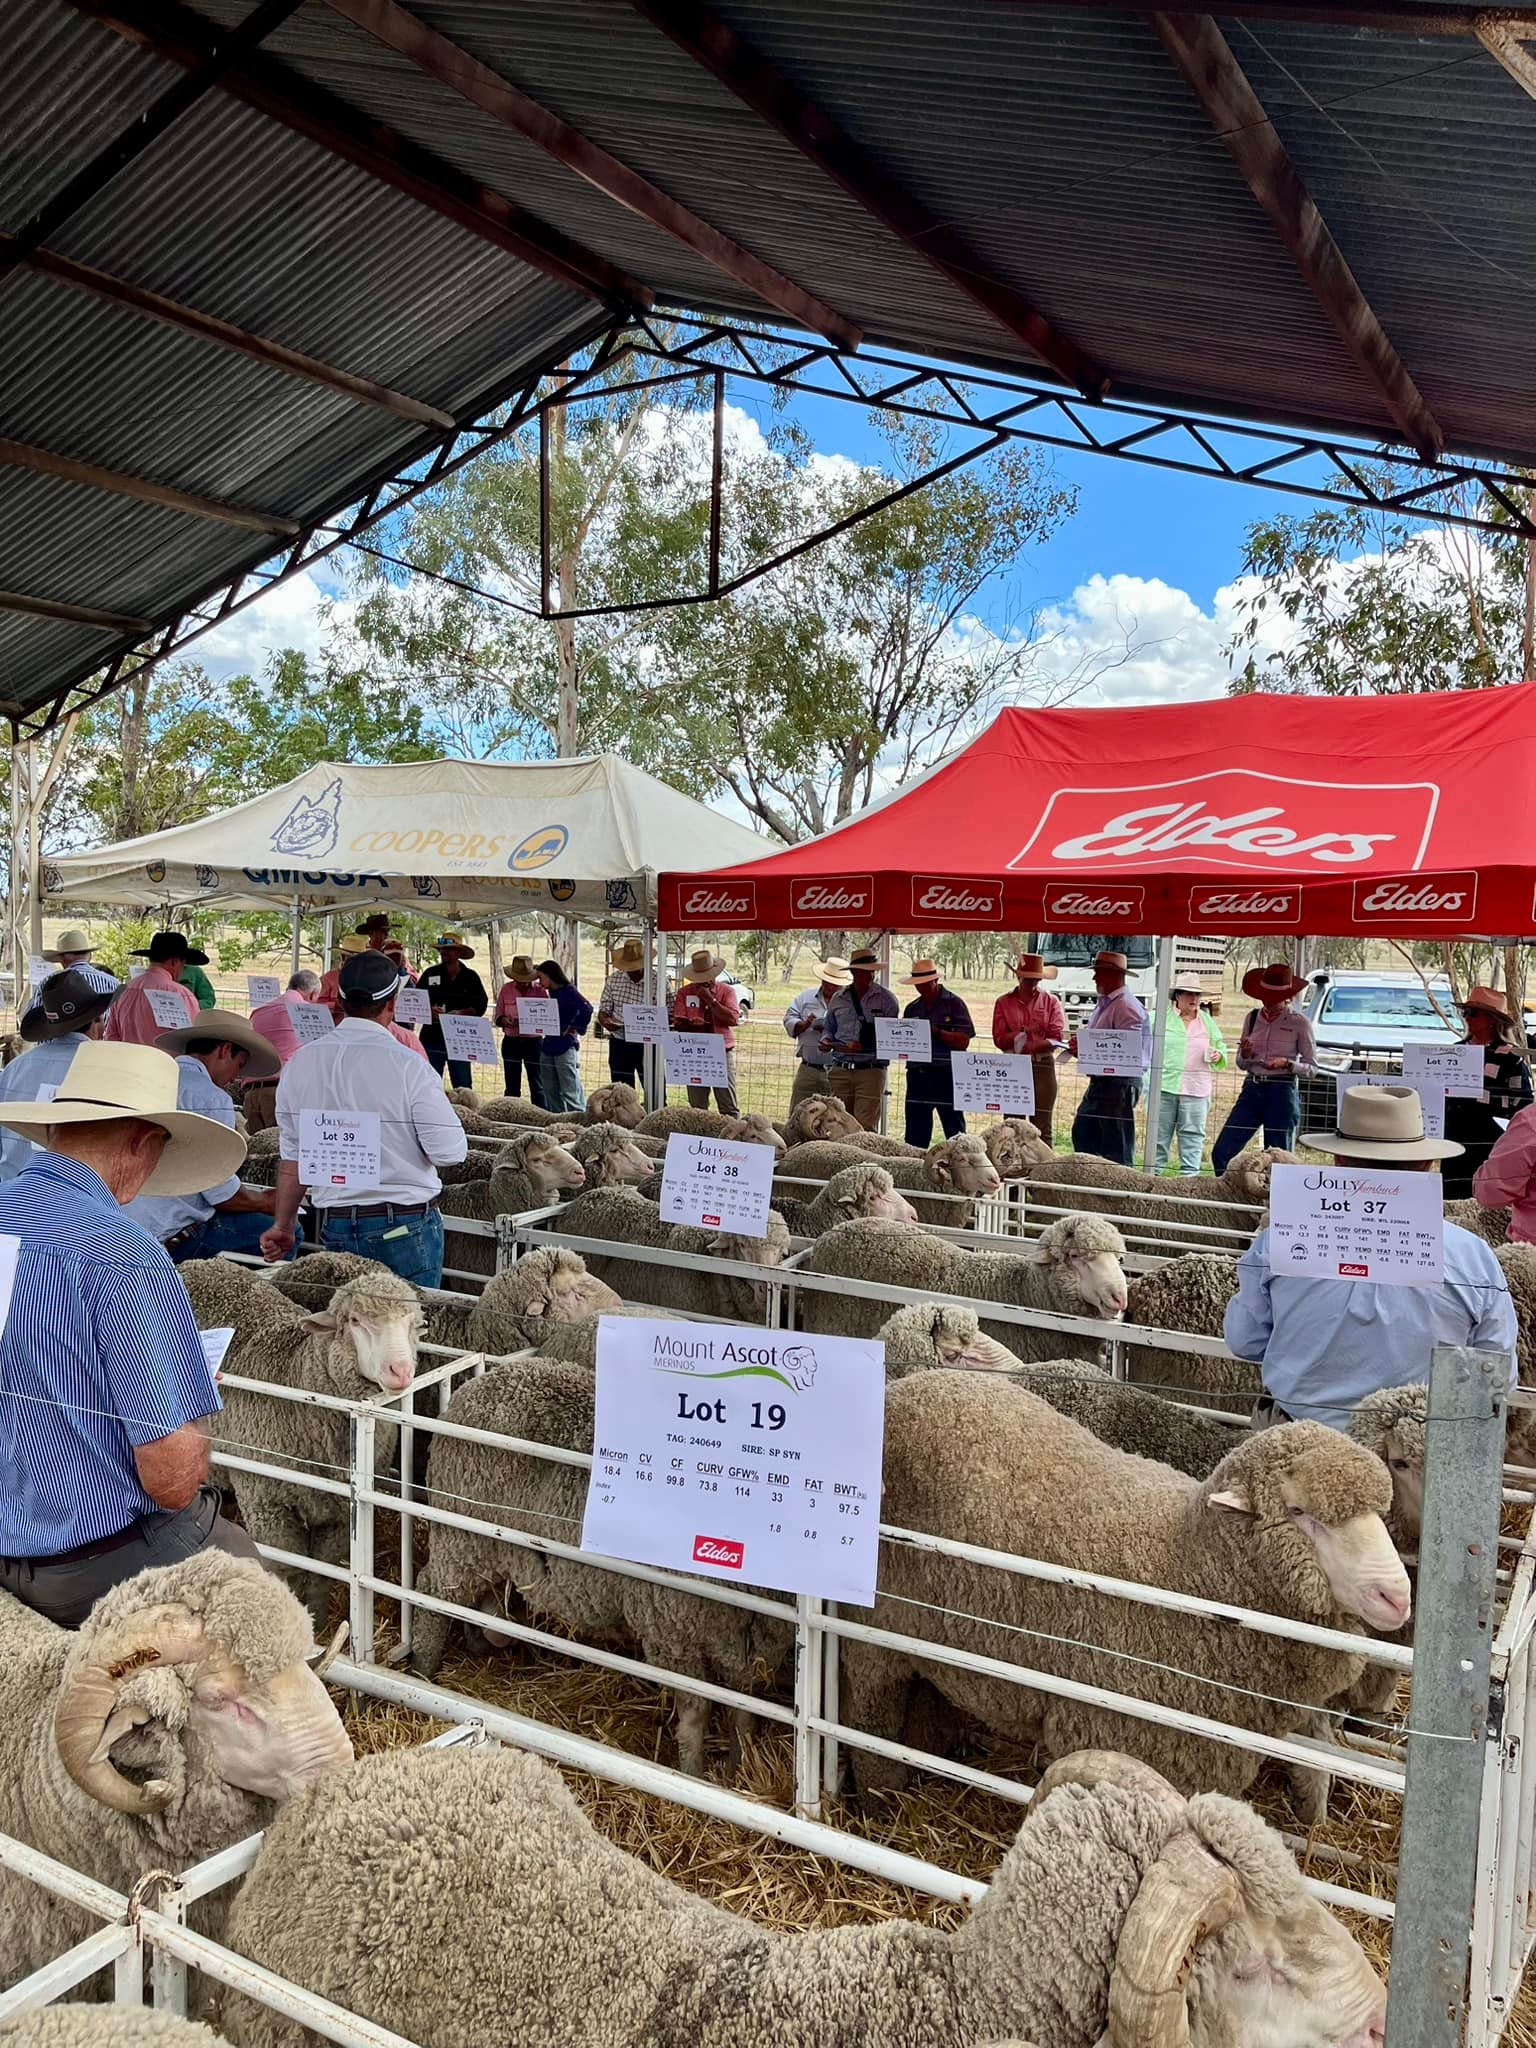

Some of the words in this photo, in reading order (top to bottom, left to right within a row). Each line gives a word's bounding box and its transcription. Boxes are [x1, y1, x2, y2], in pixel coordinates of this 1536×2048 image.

[1051, 801, 1396, 863] Elders
[685, 890, 748, 914] Elders
[797, 886, 868, 911] Elders
[919, 885, 994, 913] Elders
[1051, 892, 1134, 916] Elders
[1199, 891, 1292, 915] Elders
[1362, 884, 1467, 911] Elders
[323, 1131, 338, 1141] Lot
[343, 1132, 355, 1141] 39
[697, 1162, 716, 1174] Lot
[724, 1166, 738, 1177] 38
[1320, 1199, 1351, 1212] Lot
[1363, 1202, 1387, 1214] 37
[653, 1336, 714, 1360] Mount
[722, 1342, 778, 1366] Ascot
[653, 1358, 696, 1371] MERINOS
[677, 1393, 727, 1423] Lot
[750, 1403, 787, 1430] 19
[666, 1433, 687, 1444] TAG:
[689, 1436, 722, 1449] 240649
[741, 1444, 766, 1456] SIRE:
[769, 1448, 780, 1458] SP
[782, 1450, 801, 1461] SYN
[600, 1448, 628, 1461] Micron
[639, 1453, 652, 1464] CV
[671, 1458, 683, 1469] CF
[696, 1462, 724, 1475] CURV
[728, 1466, 759, 1480] GFW%
[767, 1473, 789, 1485] EMD
[804, 1478, 824, 1490] FAT
[603, 1465, 621, 1477] 18.4
[635, 1470, 653, 1481] 16.6
[666, 1475, 685, 1487] 99.8
[699, 1480, 718, 1492] 73.8
[735, 1486, 750, 1497] 114
[771, 1492, 783, 1503] 33
[809, 1498, 816, 1508] 3
[838, 1503, 860, 1516] 97.5
[601, 1495, 616, 1504] -0.7
[769, 1524, 781, 1533] 1.8
[804, 1530, 817, 1540] 0.8
[840, 1536, 854, 1546] 5.7
[696, 1540, 739, 1564] Elders
